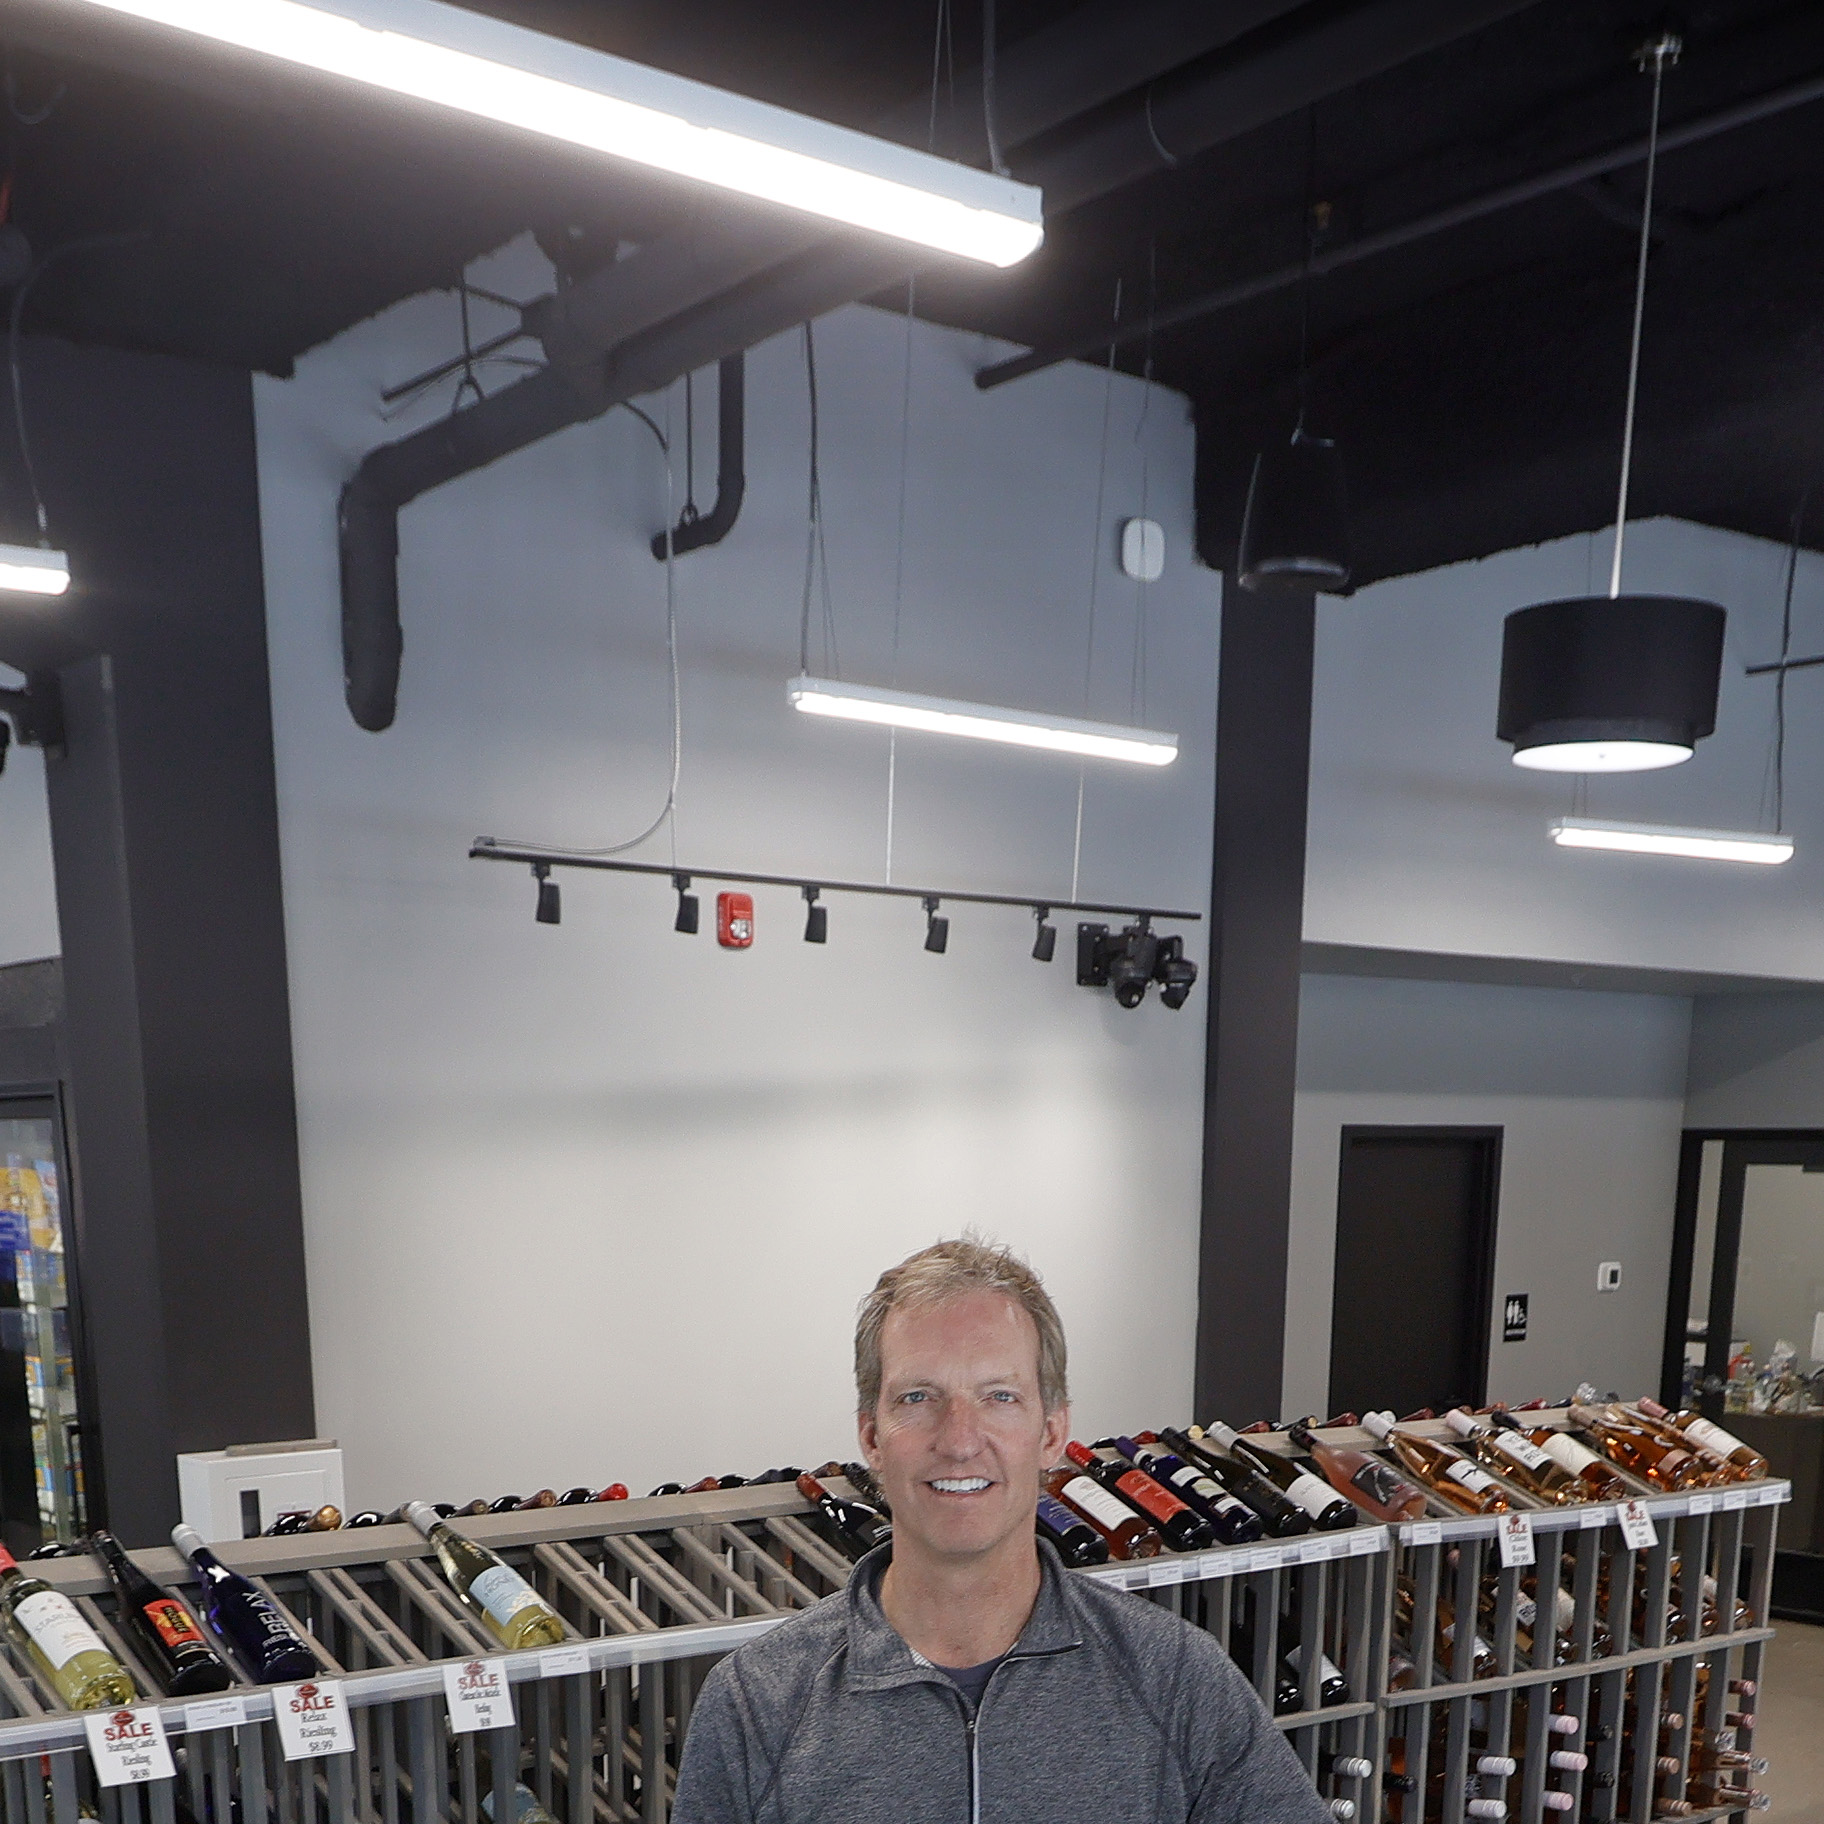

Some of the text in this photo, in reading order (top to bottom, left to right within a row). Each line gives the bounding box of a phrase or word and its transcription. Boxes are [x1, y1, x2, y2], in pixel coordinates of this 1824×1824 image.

[242, 1591, 290, 1634] RELAX
[457, 1673, 500, 1690] SALE
[290, 1695, 336, 1713] SALE
[104, 1722, 154, 1741] SALE
